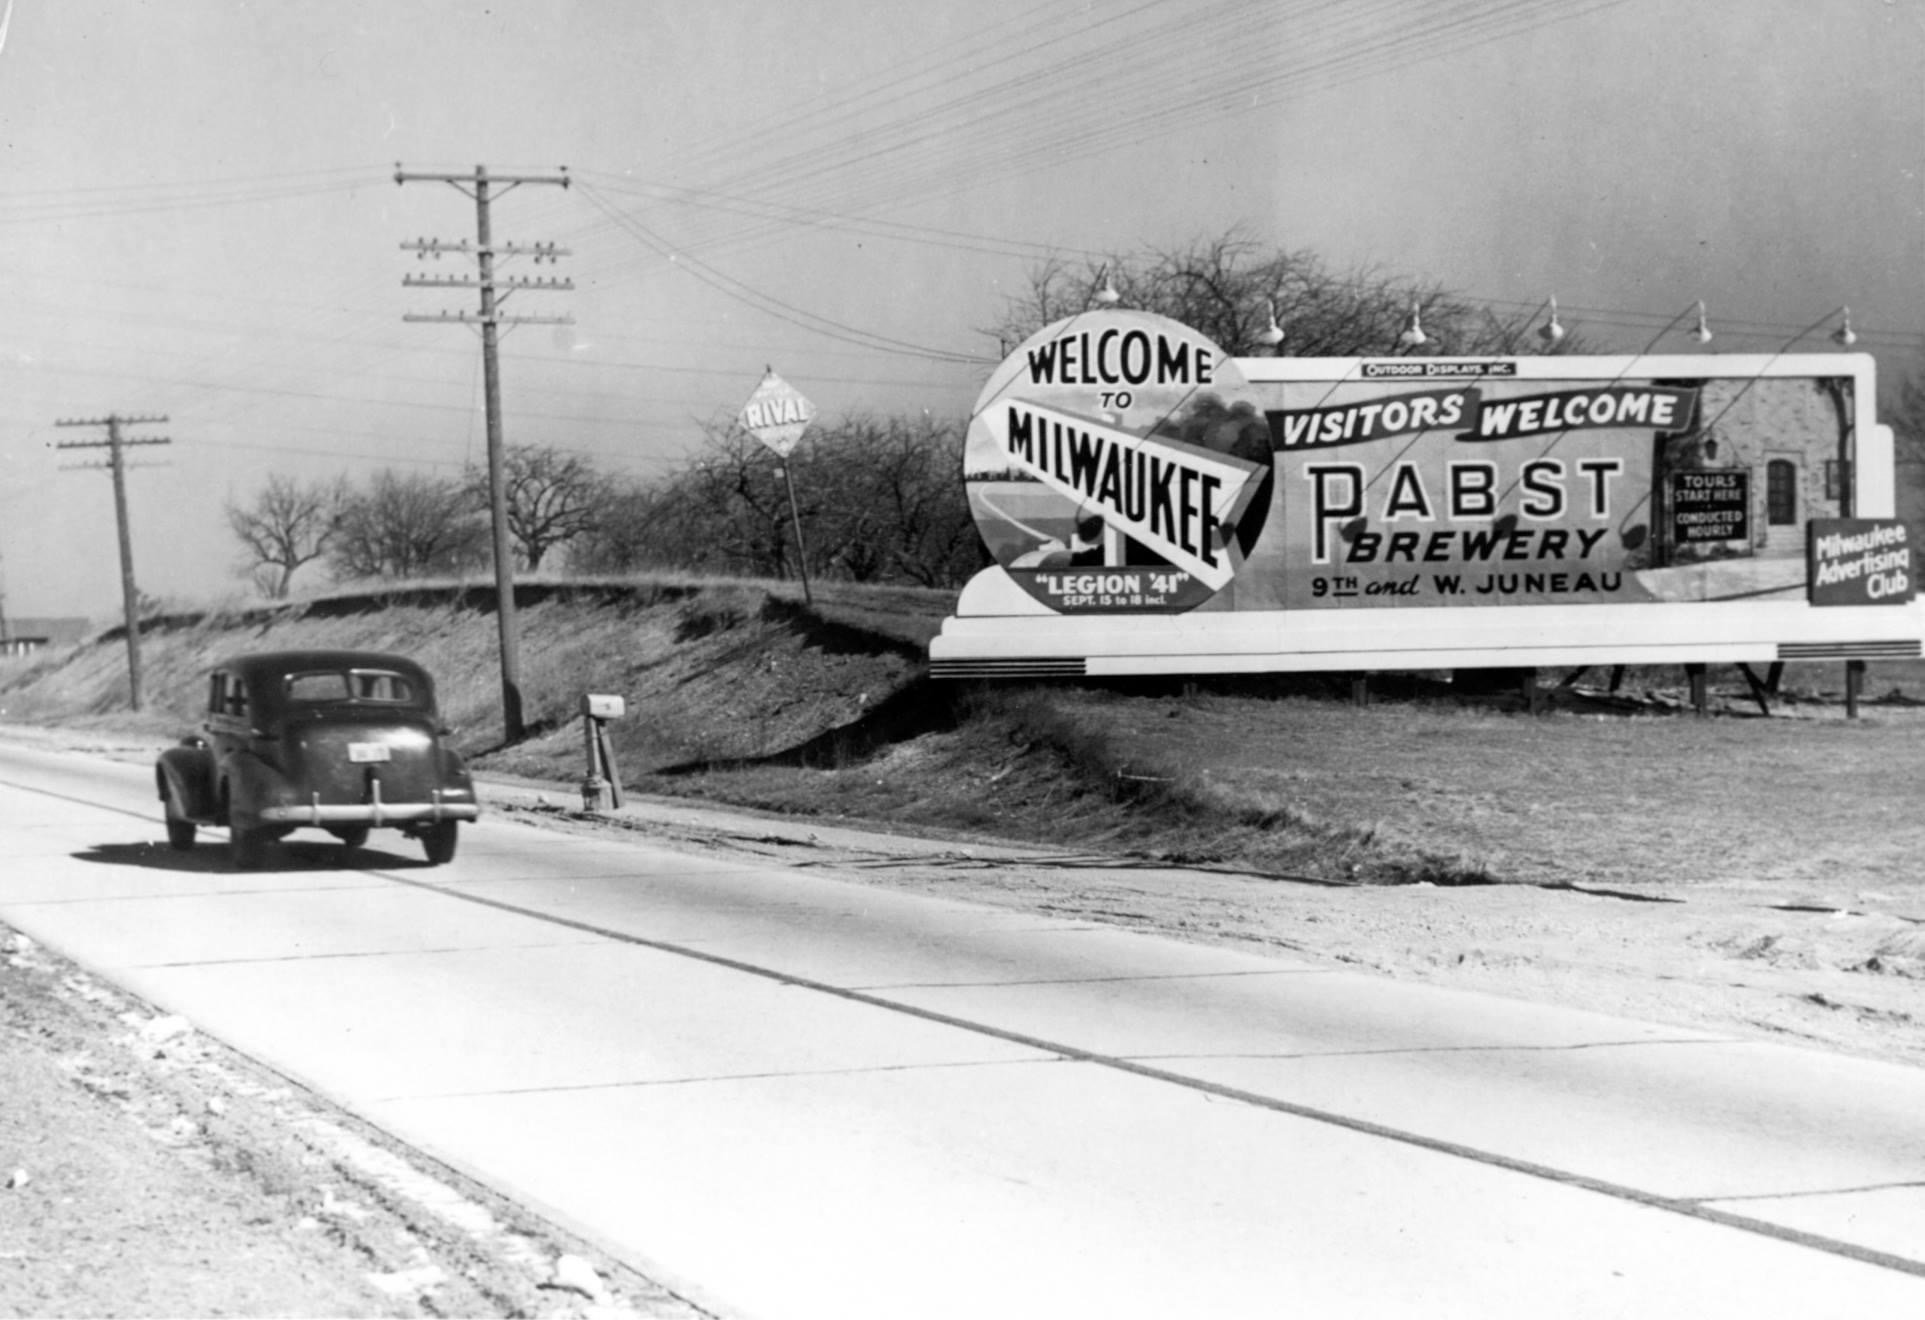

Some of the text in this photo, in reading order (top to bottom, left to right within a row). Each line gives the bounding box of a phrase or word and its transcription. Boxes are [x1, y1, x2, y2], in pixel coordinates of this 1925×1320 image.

[1028, 328, 1212, 385] WELCOME
[744, 398, 808, 430] RIVAL
[1099, 391, 1133, 409] TO
[1283, 392, 1679, 445] VISITORS WELCOME
[1008, 406, 1221, 570] MILWAUKEE
[1676, 489, 1711, 502] START
[1683, 475, 1736, 489] TOURS
[1303, 458, 1624, 565] PABST
[1676, 510, 1743, 524] CONDUCTED
[1345, 528, 1607, 564] BREWERY
[1687, 524, 1734, 538] HOURLY
[1816, 523, 1907, 561] Milwaukee
[1815, 547, 1910, 587] Advertising
[1312, 572, 1622, 598] 9TH and W. JUNEAU
[1866, 568, 1909, 599] Club
[1063, 594, 1096, 606] SEPT.
[1099, 594, 1112, 606] 15
[1115, 594, 1127, 606] to
